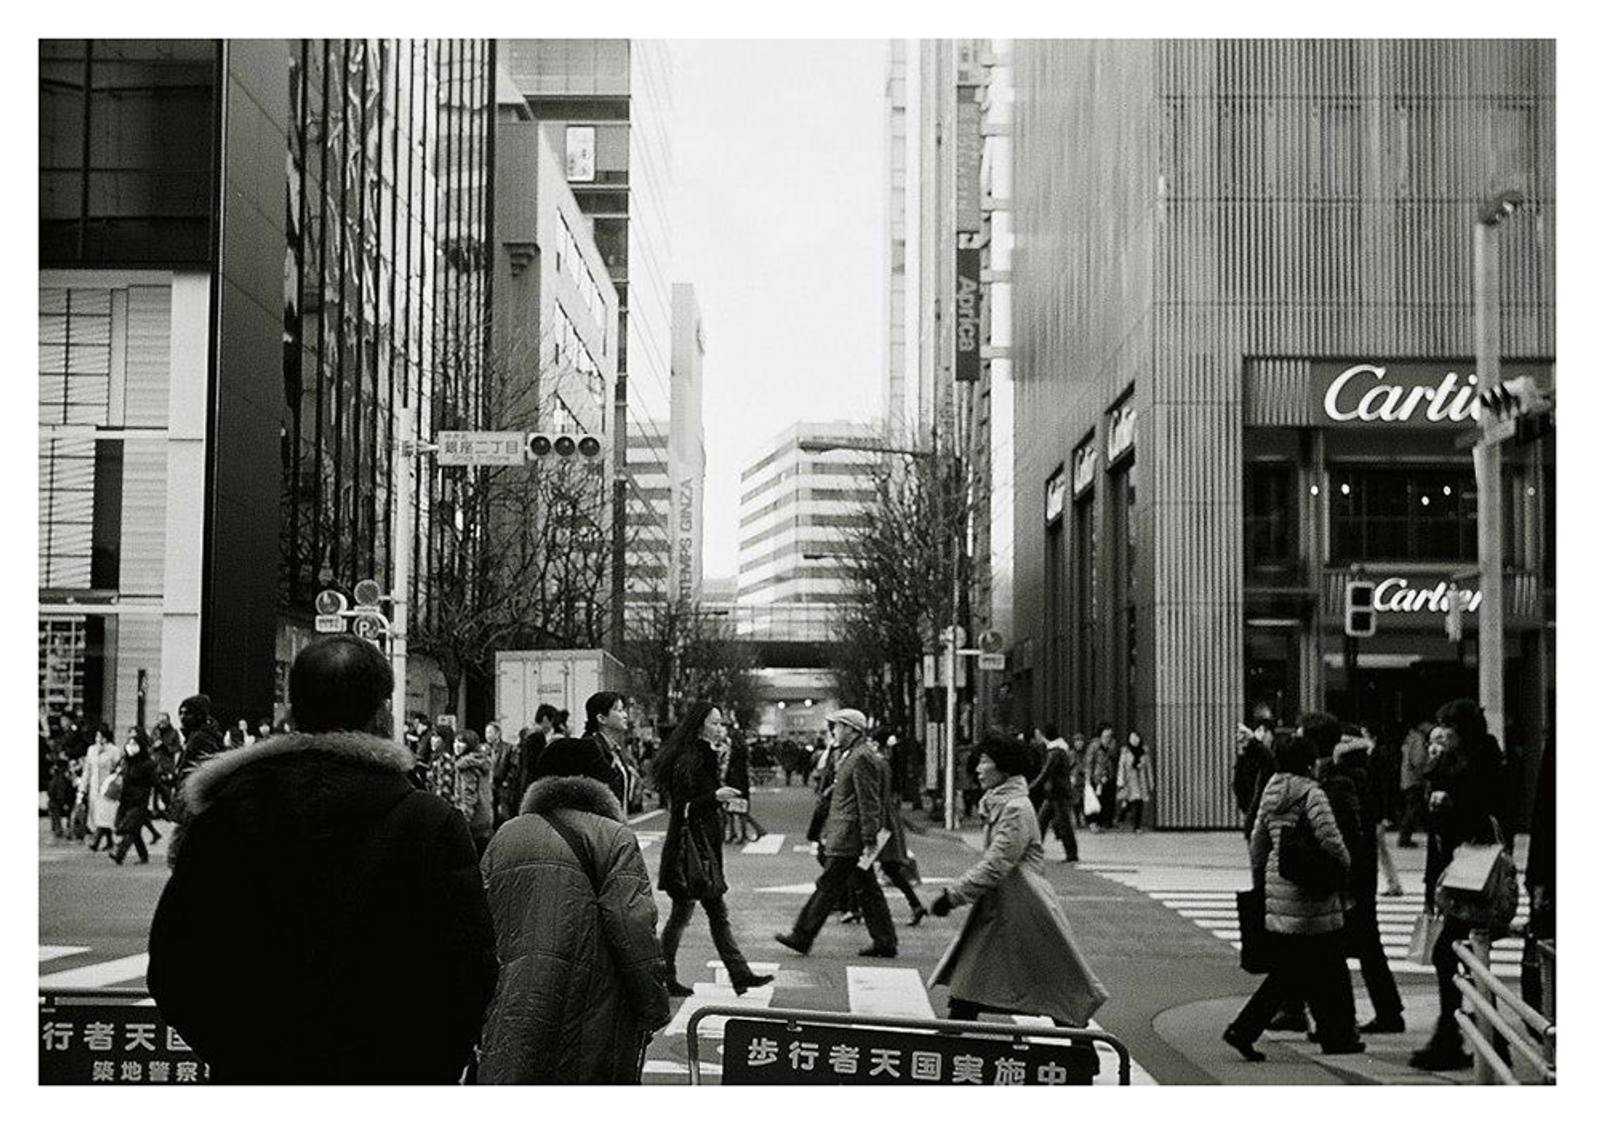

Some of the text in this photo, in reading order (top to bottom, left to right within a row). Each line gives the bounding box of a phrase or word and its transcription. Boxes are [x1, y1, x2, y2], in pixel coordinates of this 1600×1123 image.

[957, 275, 980, 352] Aprica
[1324, 364, 1481, 422] Carti
[680, 477, 693, 533] GINZA
[92, 1060, 210, 1082] 築地警察
[748, 1037, 1067, 1086] 歩行者天国実施中
